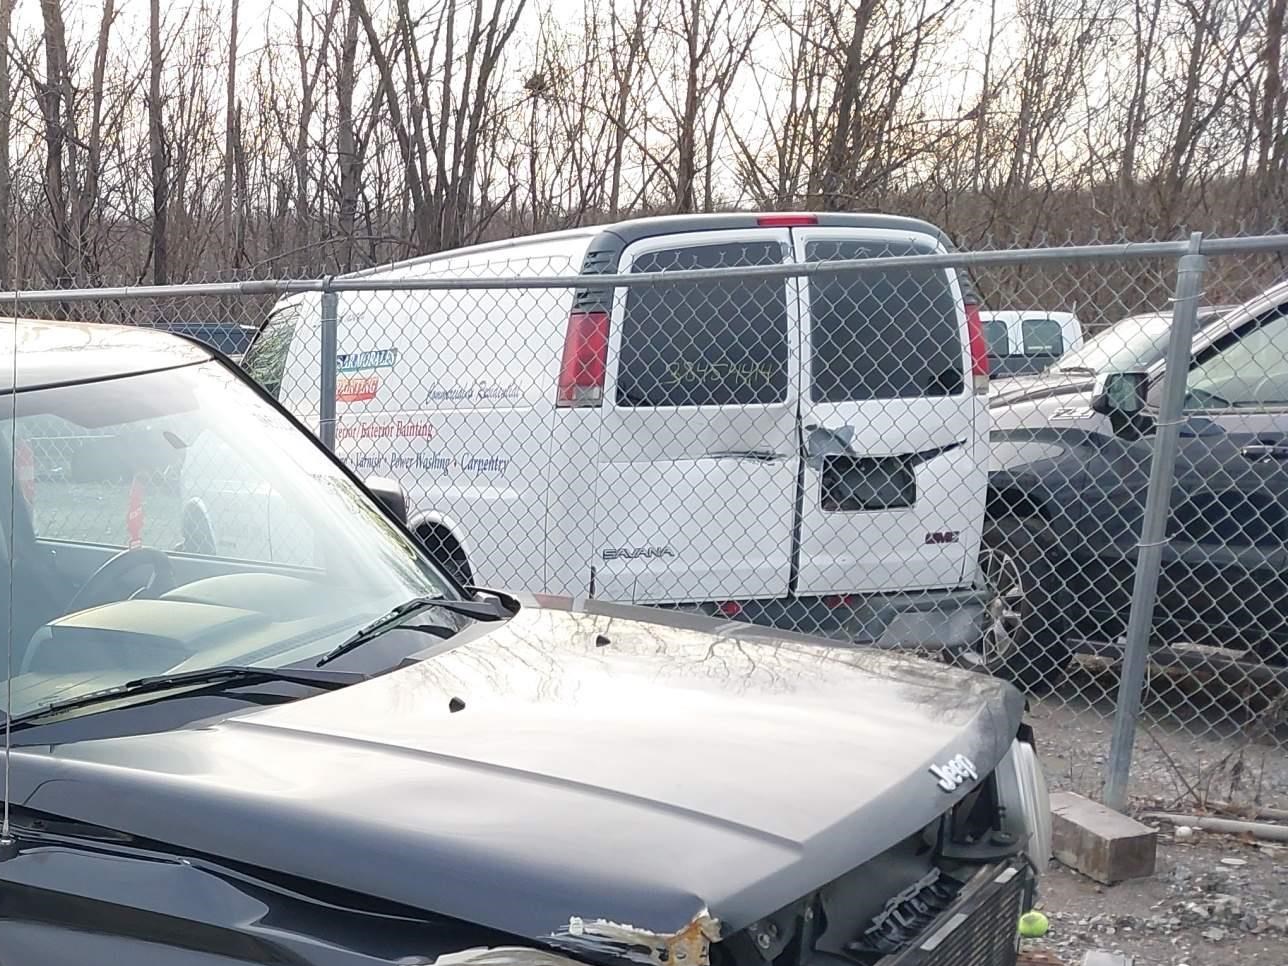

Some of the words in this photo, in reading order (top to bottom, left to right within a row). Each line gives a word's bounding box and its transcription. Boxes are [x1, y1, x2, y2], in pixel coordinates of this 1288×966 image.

[390, 452, 413, 469] Power
[460, 453, 509, 478] Carpentry
[928, 753, 978, 791] Jeep
